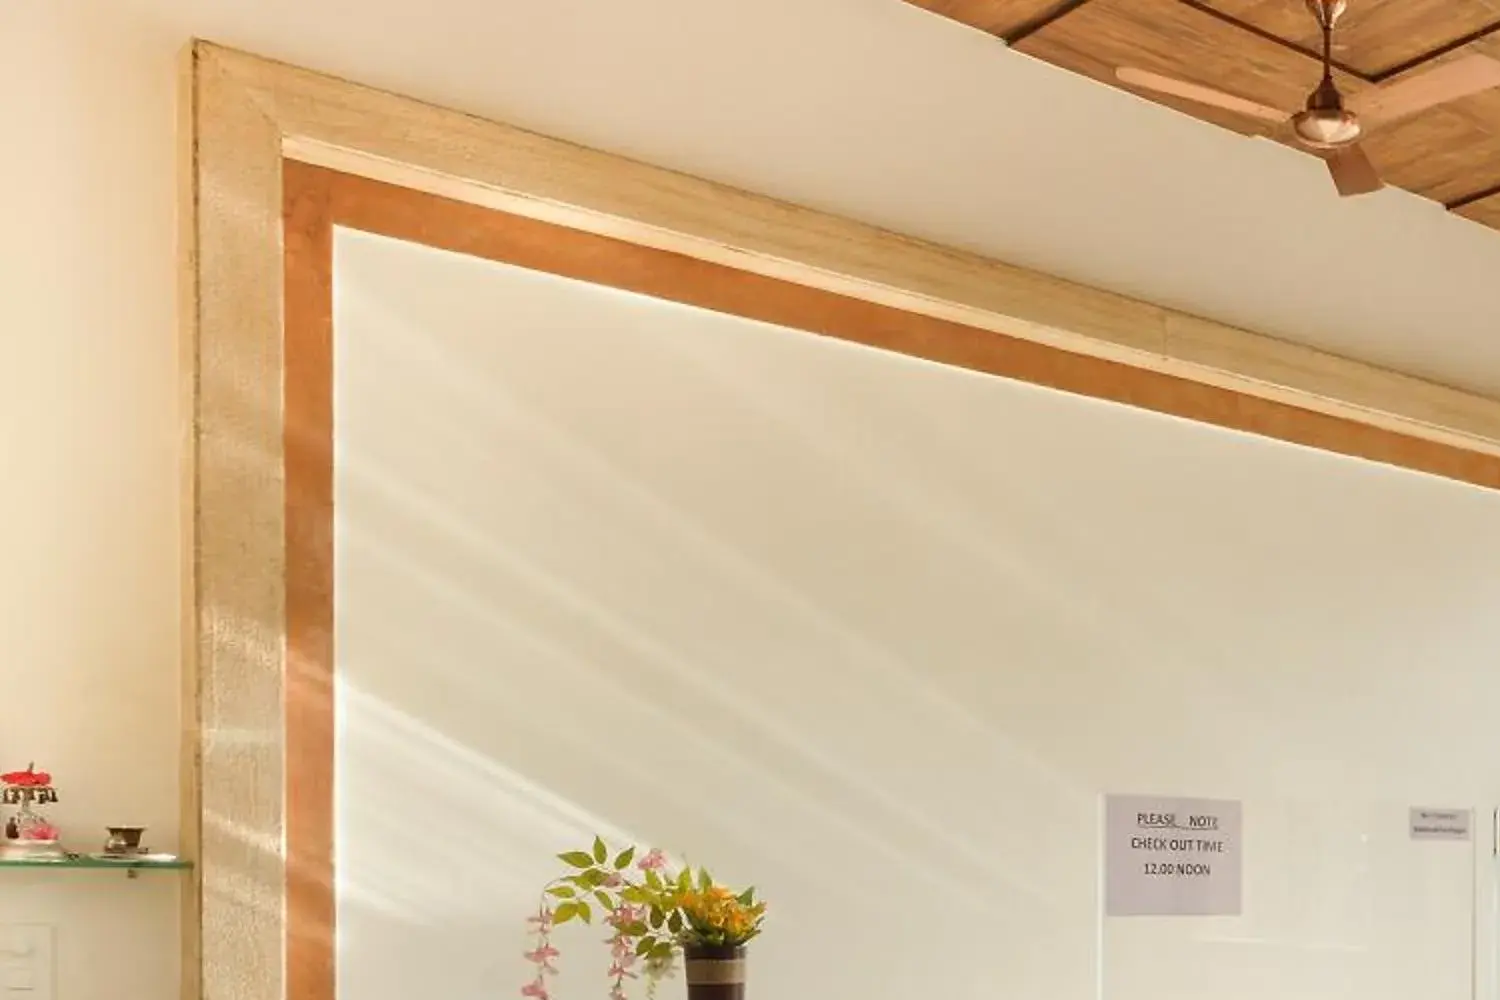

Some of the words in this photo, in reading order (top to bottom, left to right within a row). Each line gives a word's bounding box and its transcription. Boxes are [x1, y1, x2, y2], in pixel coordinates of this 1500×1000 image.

[1137, 813, 1176, 826] PLEASE
[1189, 815, 1219, 828] NOTE
[1131, 837, 1167, 851] CHECK
[1169, 838, 1194, 852] OUT
[1196, 839, 1224, 853] TIME
[1177, 863, 1211, 875] NOON
